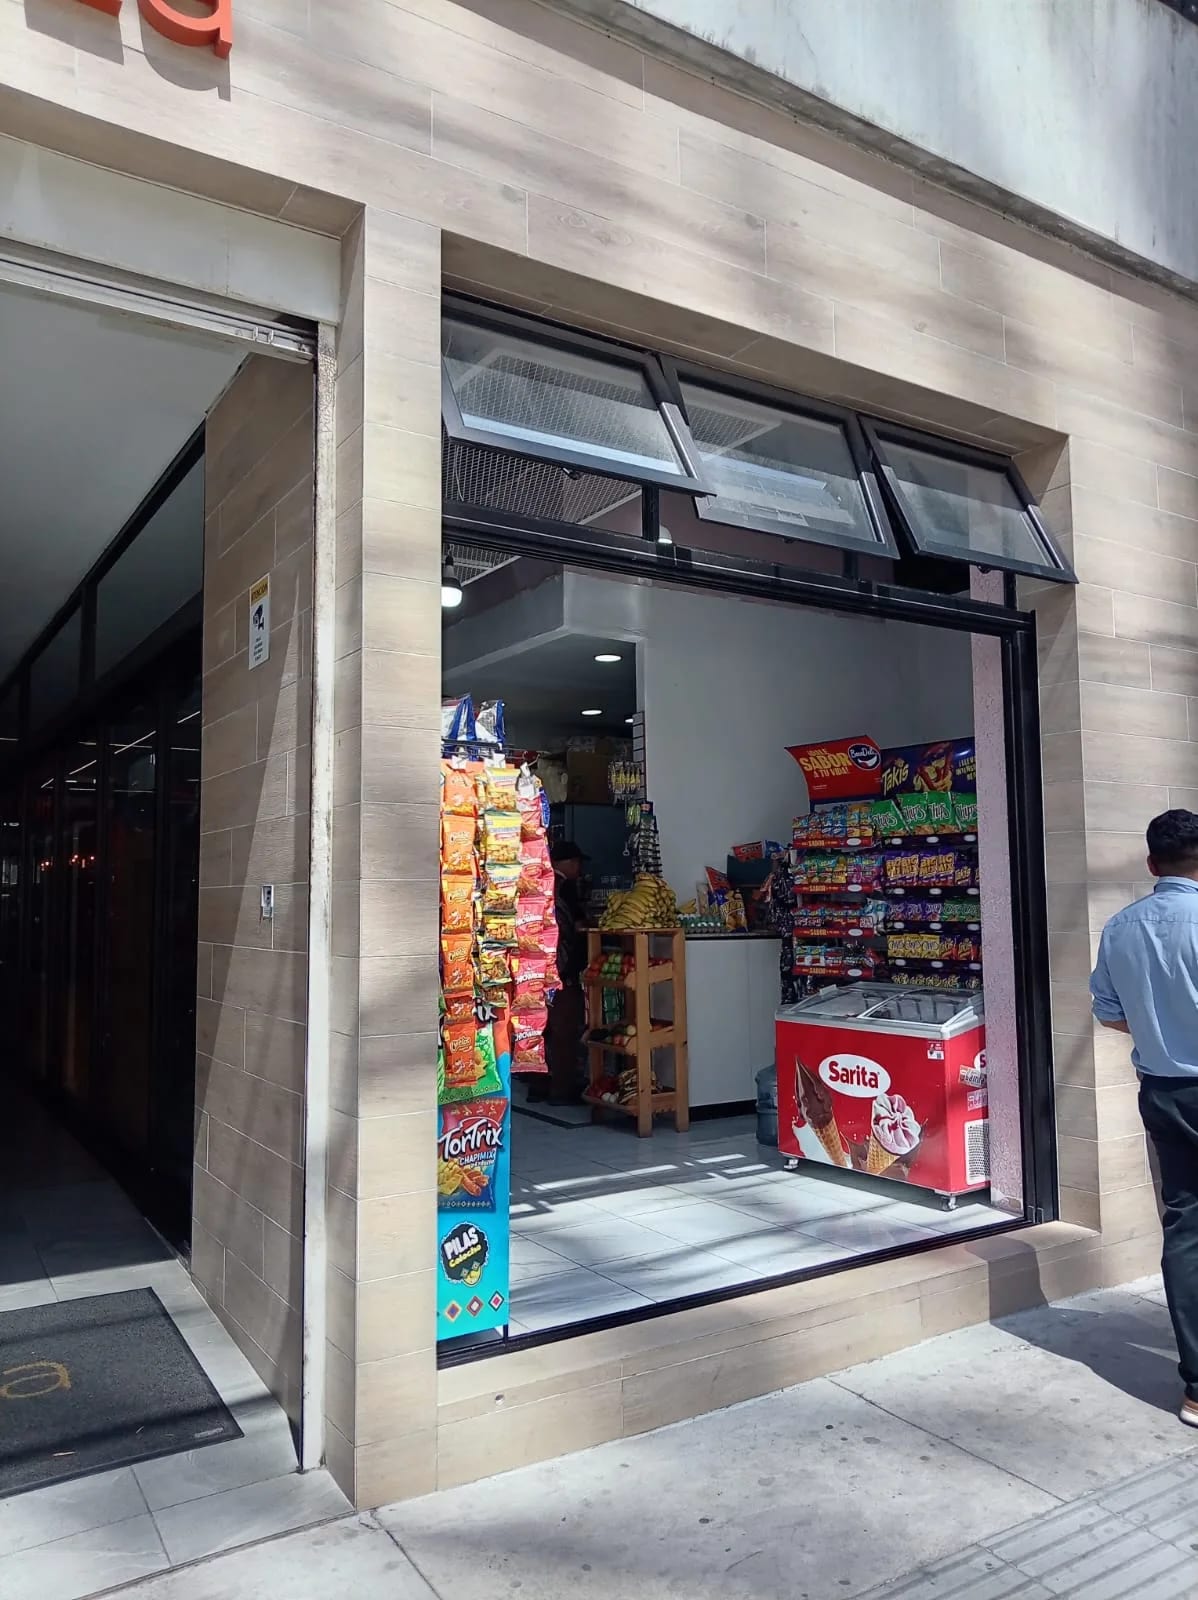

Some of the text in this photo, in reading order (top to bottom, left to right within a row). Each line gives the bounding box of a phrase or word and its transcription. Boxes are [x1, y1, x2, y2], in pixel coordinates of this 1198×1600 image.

[800, 752, 852, 771] SABOR
[882, 763, 909, 796] Takis
[828, 1060, 879, 1089] Sarita
[437, 1118, 503, 1160] TorTrix
[443, 1226, 478, 1260] PILAS
